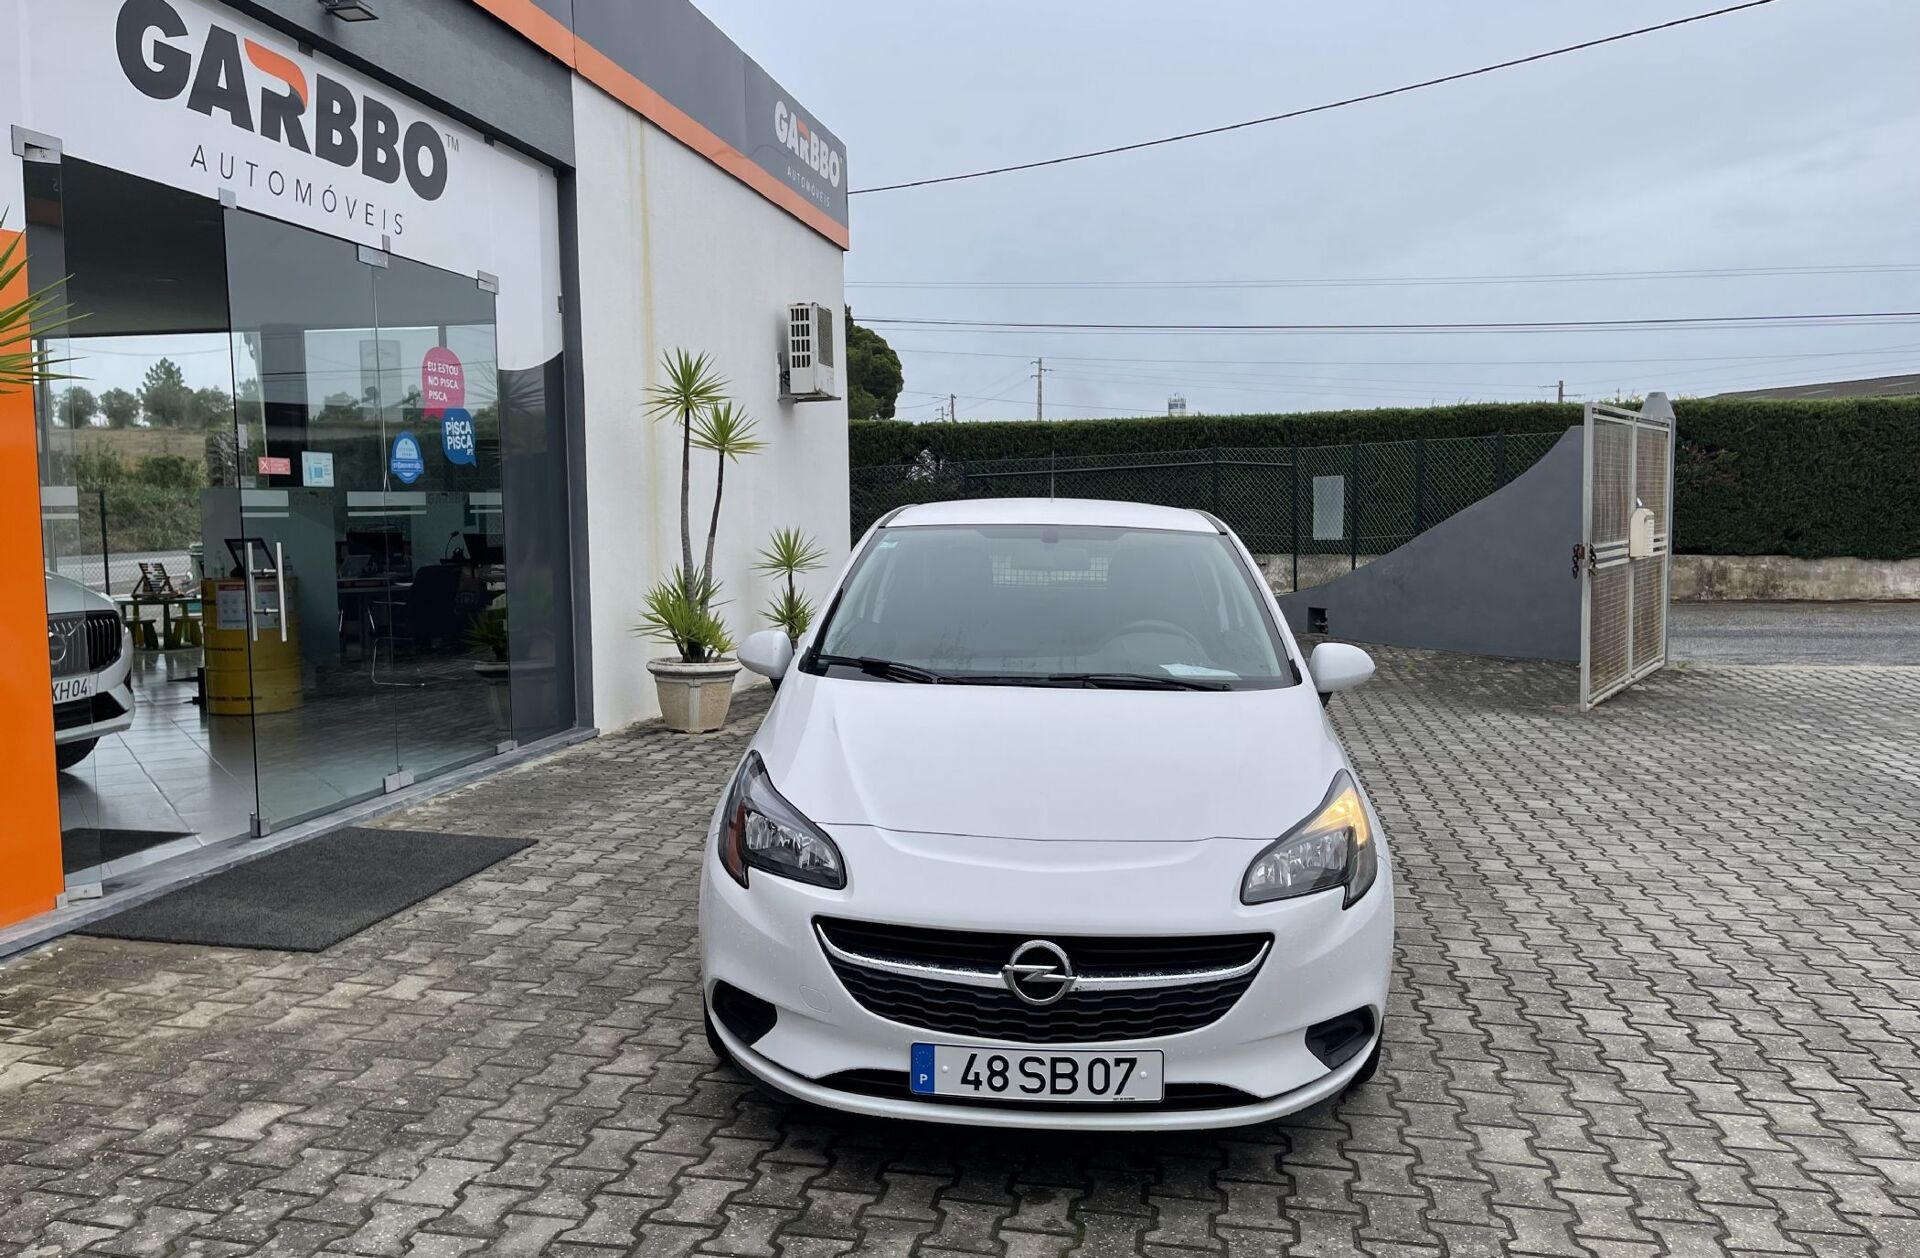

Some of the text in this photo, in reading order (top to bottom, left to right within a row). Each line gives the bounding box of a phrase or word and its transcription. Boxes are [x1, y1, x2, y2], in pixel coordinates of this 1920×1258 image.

[115, 0, 448, 202] GARBBO
[774, 100, 840, 188] GARBBO
[190, 144, 404, 236] AUTOMÓVEIS
[427, 362, 459, 376] EU ESTOU
[428, 376, 459, 389] NO PISCA
[428, 391, 448, 402] PISCA
[447, 435, 473, 450] PISCA
[919, 1073, 928, 1085] P
